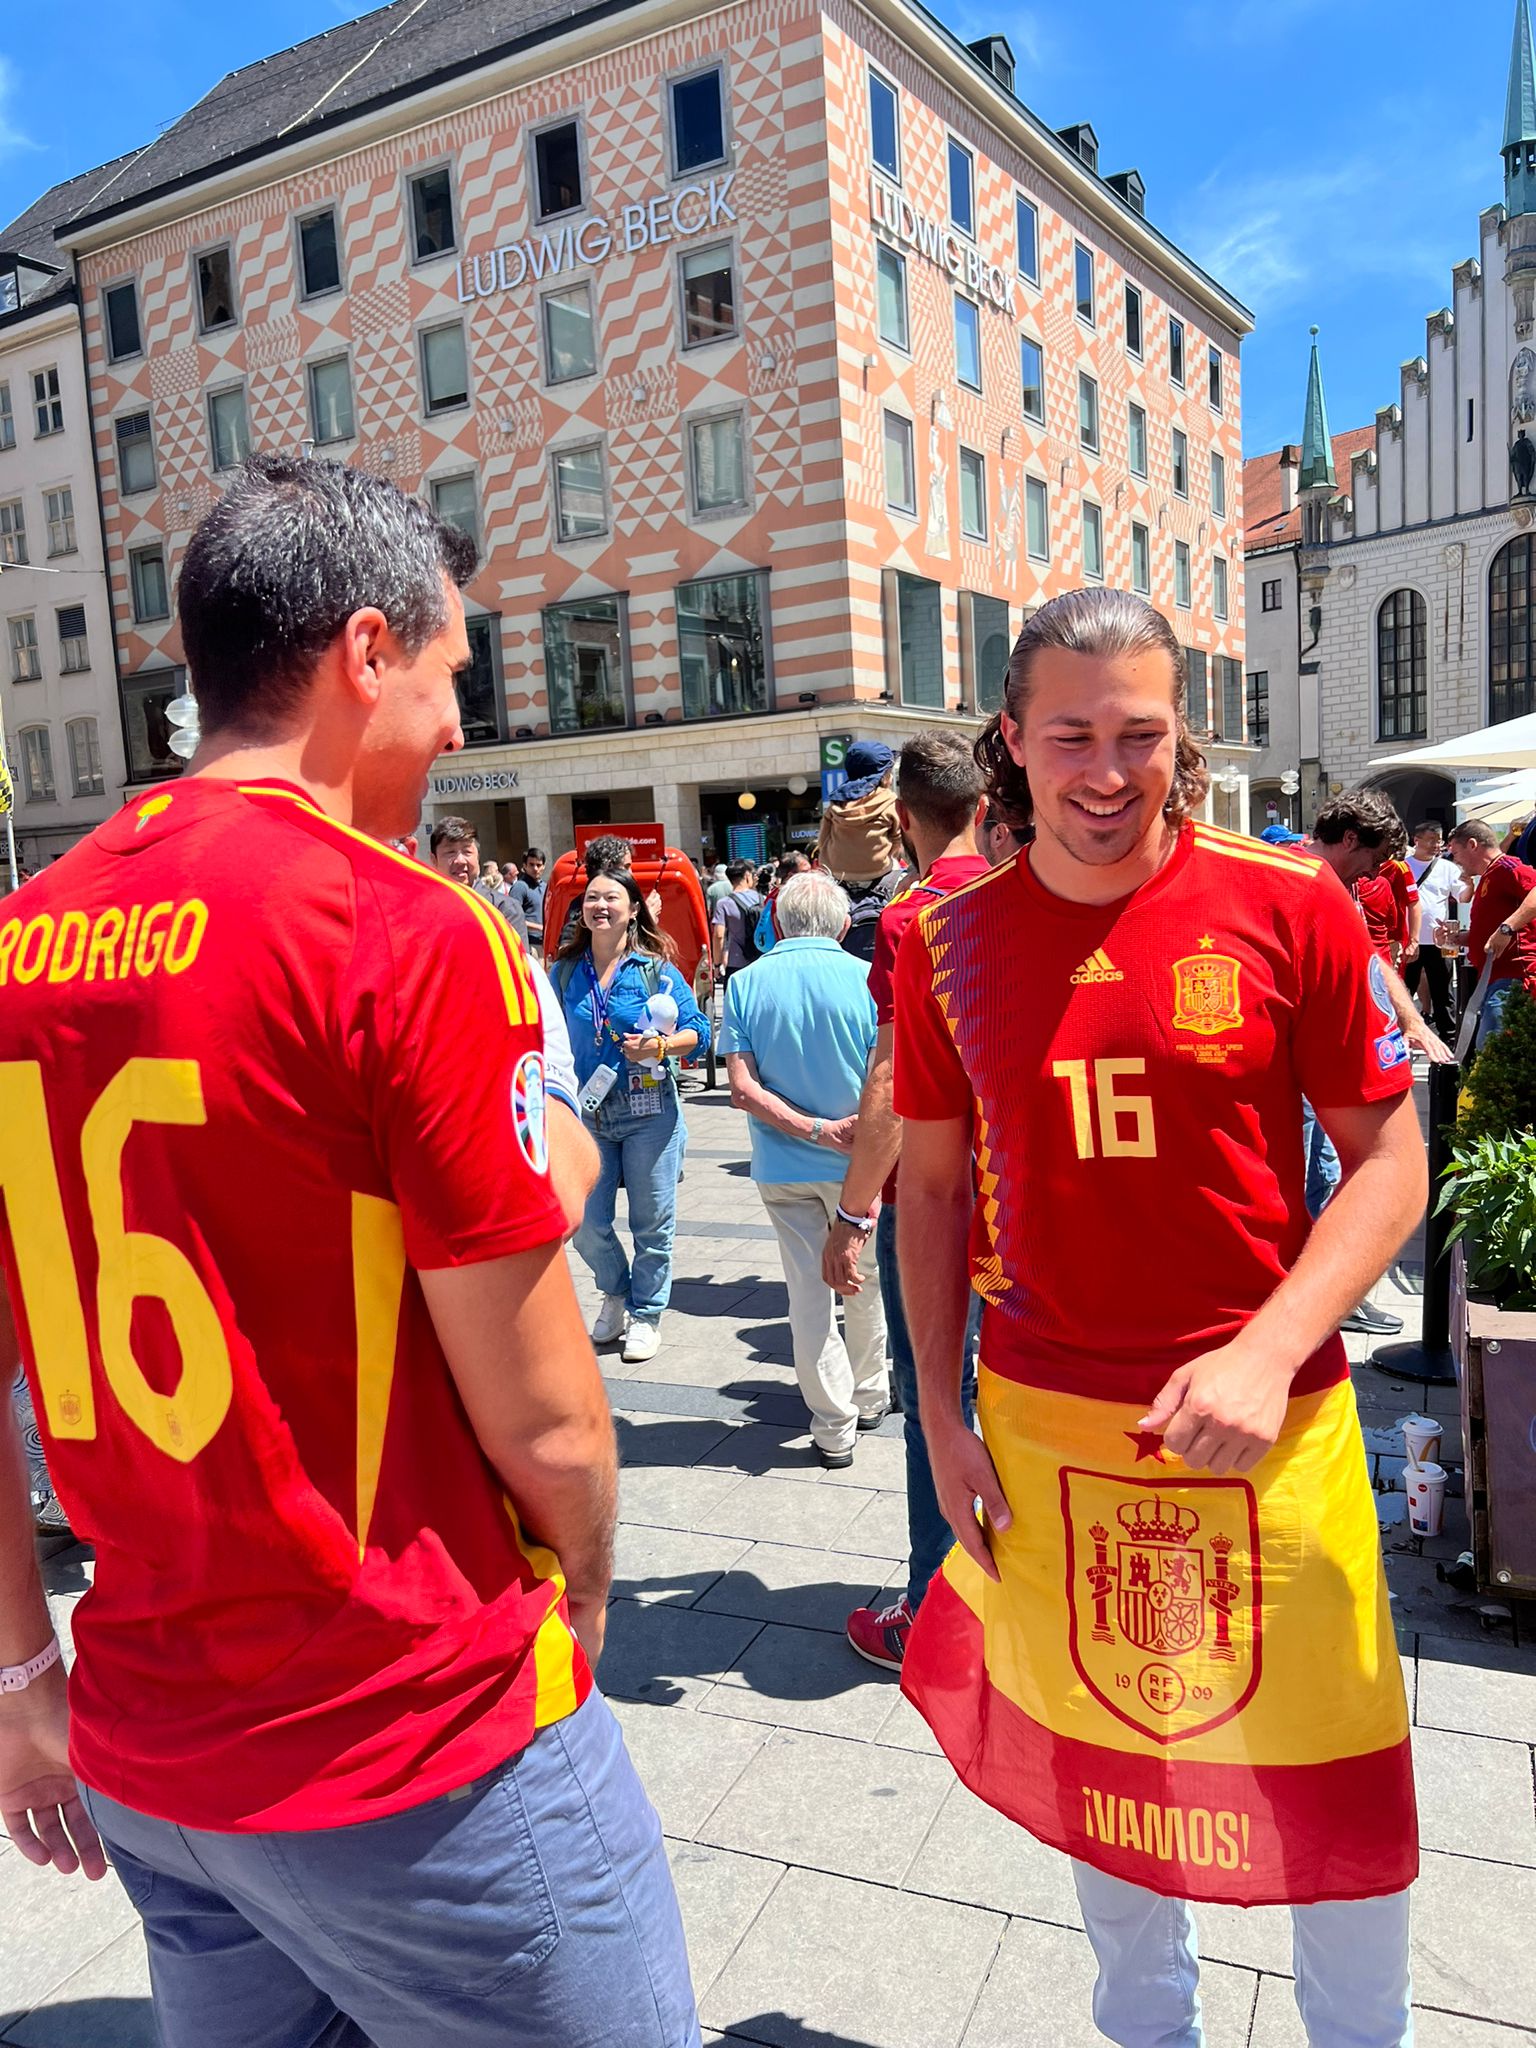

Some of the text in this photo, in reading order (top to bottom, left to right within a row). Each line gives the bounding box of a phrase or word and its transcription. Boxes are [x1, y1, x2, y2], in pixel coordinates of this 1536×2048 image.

[455, 173, 737, 303] LUDWIG BECK
[870, 174, 1017, 318] LUDWIG BECK
[825, 740, 844, 765] S
[433, 772, 518, 794] LUDWIG BECK
[1070, 969, 1124, 985] adidas
[1052, 1057, 1157, 1160] 16
[0, 1057, 232, 1463] 16
[1115, 1672, 1131, 1688] 19
[1192, 1685, 1213, 1700] 09
